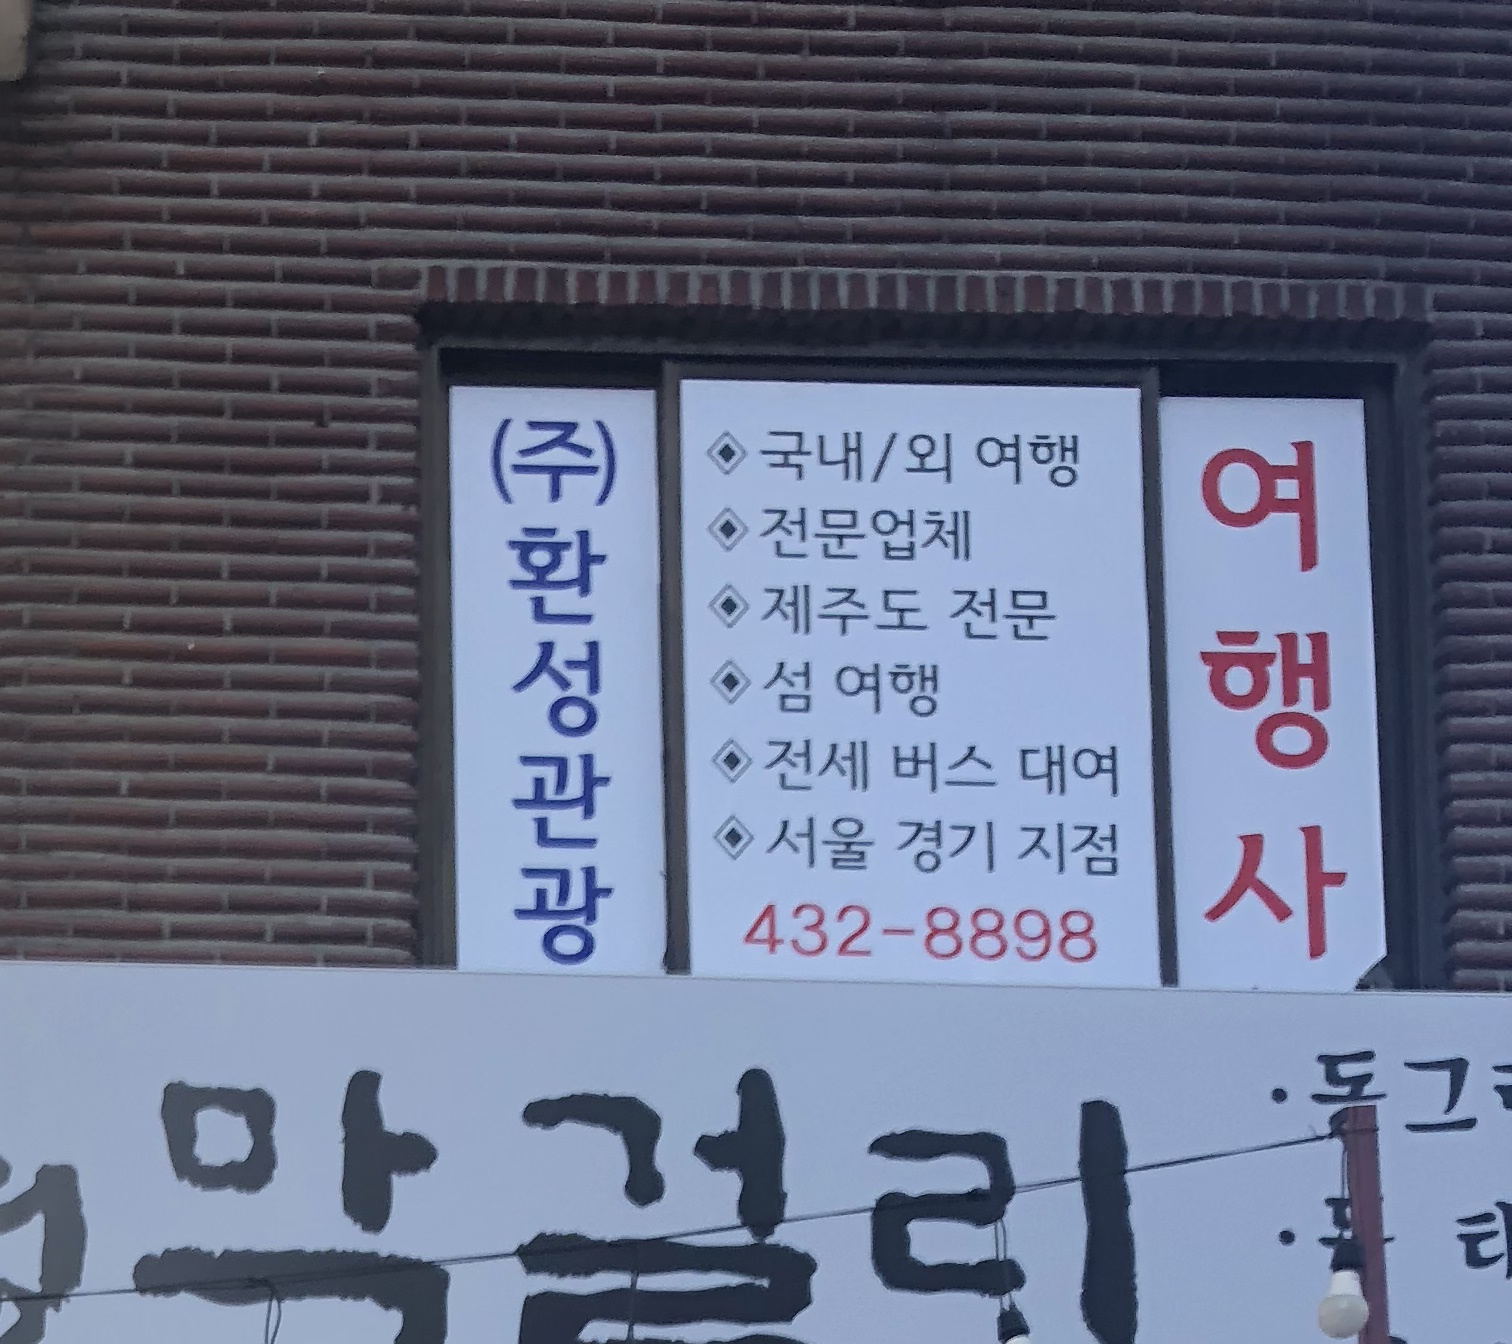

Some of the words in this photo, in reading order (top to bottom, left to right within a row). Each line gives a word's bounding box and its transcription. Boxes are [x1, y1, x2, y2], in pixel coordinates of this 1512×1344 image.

[759, 429, 953, 485] 국내/외
[977, 433, 1081, 489] 여행
[759, 507, 972, 564] 전문업체
[761, 584, 928, 640] 제주도
[950, 587, 1058, 643] 전문
[763, 660, 814, 715] 섬
[836, 662, 941, 718] 여행
[1199, 438, 1348, 961] 여행사
[764, 737, 871, 794] 전세
[891, 740, 997, 792] 버스
[1020, 744, 1120, 799] 대여
[765, 816, 875, 871] 서울
[898, 817, 997, 873] 경기
[1017, 820, 1120, 878] 지점
[742, 903, 1099, 964] 432-8898
